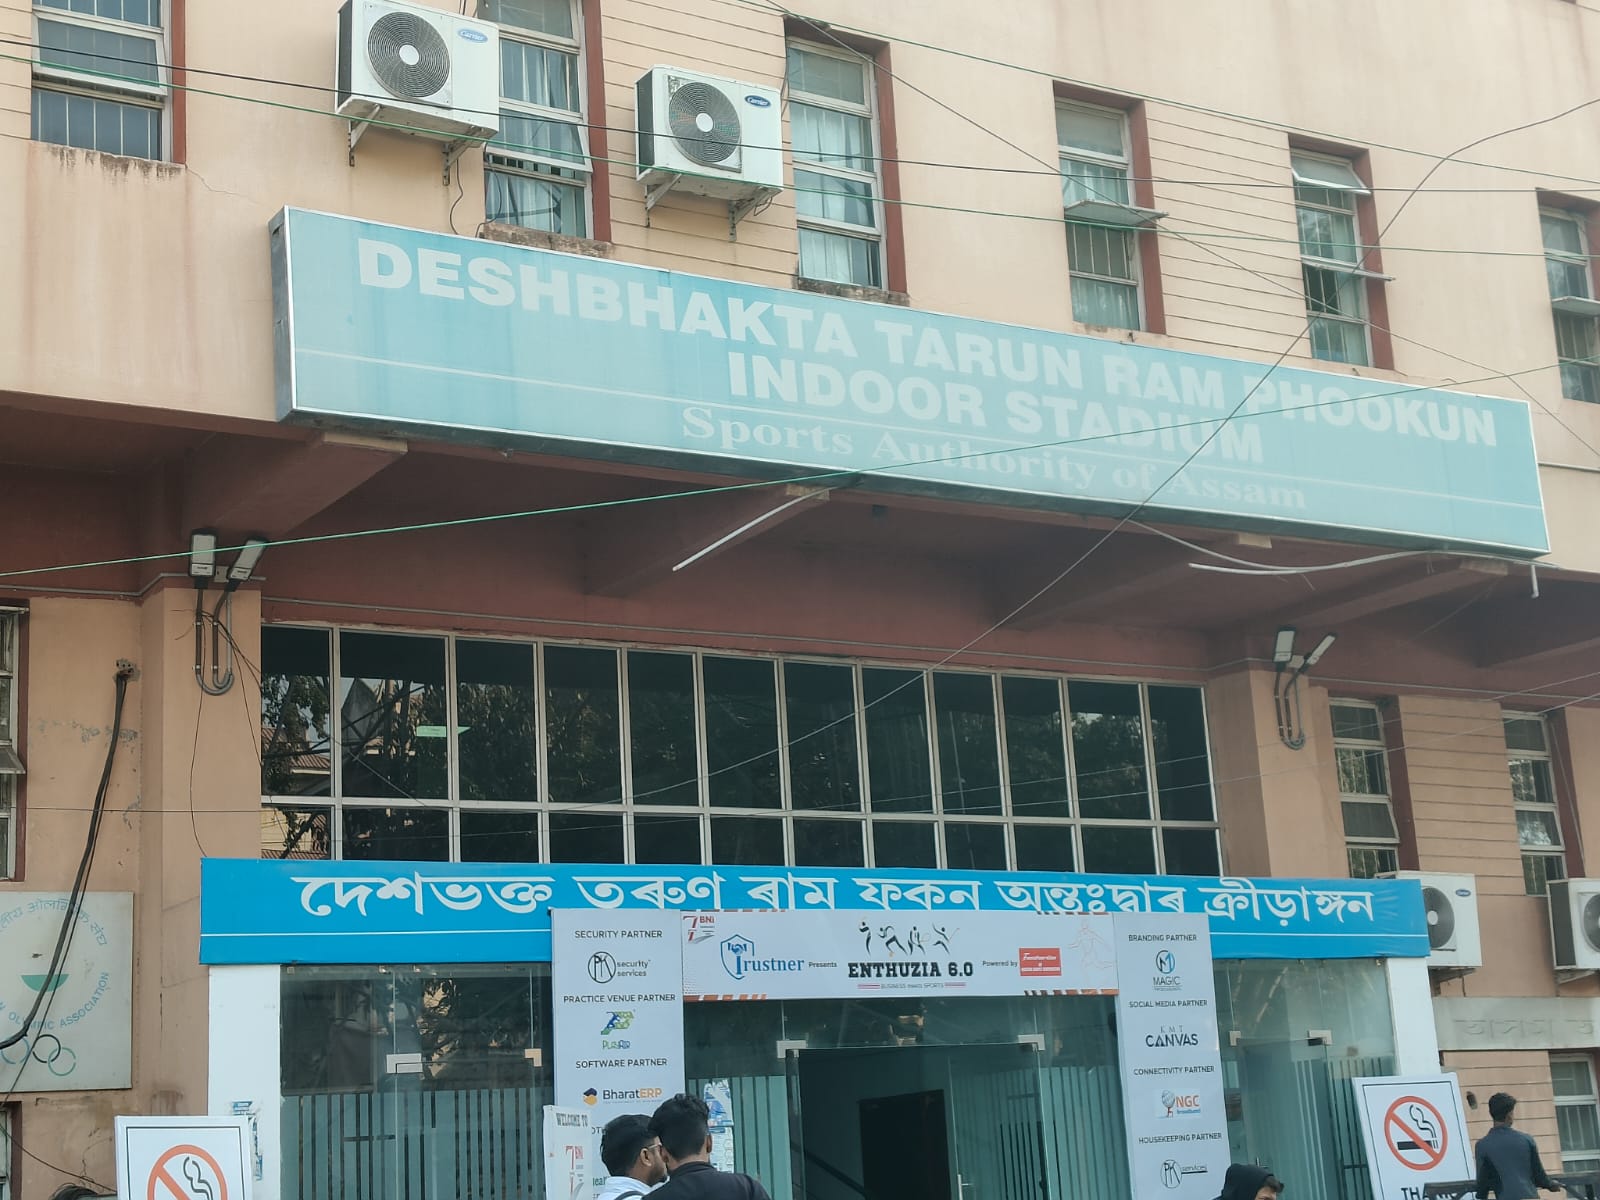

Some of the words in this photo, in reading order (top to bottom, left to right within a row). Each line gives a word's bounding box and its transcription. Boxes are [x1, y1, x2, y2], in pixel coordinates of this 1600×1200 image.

[358, 238, 858, 358] DESHBHAKTA
[873, 319, 1082, 389] TARUN
[1102, 354, 1225, 409] RAM
[1243, 376, 1498, 447] PHOOKUN
[728, 351, 987, 427] INDOOR
[1005, 390, 1265, 464] STADIUM
[682, 406, 855, 455] Sports
[871, 430, 1097, 490] Authority
[1112, 463, 1157, 490] of
[1170, 470, 1306, 509] Assam
[738, 871, 839, 910] ৰাম
[851, 877, 983, 910] ফকন
[574, 930, 619, 939] SECURITY
[621, 930, 663, 938] PARTNER
[1128, 934, 1165, 942] BRANDING
[617, 960, 648, 968] security
[848, 961, 942, 978] ENTHUZIA
[948, 961, 974, 977] 6.0
[1010, 960, 1018, 968] by
[617, 969, 647, 977] services
[1152, 976, 1181, 986] MAGIC
[60, 971, 110, 1027] ASSOCIATION
[563, 994, 605, 1003] PRACTICE
[607, 994, 636, 1002] VENUE
[637, 993, 676, 1002] PARTNER
[1129, 1000, 1154, 1008] SOCIAL
[1177, 999, 1208, 1007] PARTNER
[1145, 1033, 1199, 1048] CANVAS
[575, 1059, 625, 1069] SOFTWARE
[627, 1058, 668, 1067] PARTNER
[1133, 1066, 1183, 1075] CONNECTIVITY
[1184, 1065, 1215, 1073] PARTNER
[602, 1087, 662, 1100] BharatERP
[1176, 1095, 1200, 1107] NGC
[1138, 1133, 1191, 1145] HOUSEKEEPING
[1191, 1132, 1222, 1141] PARTNER
